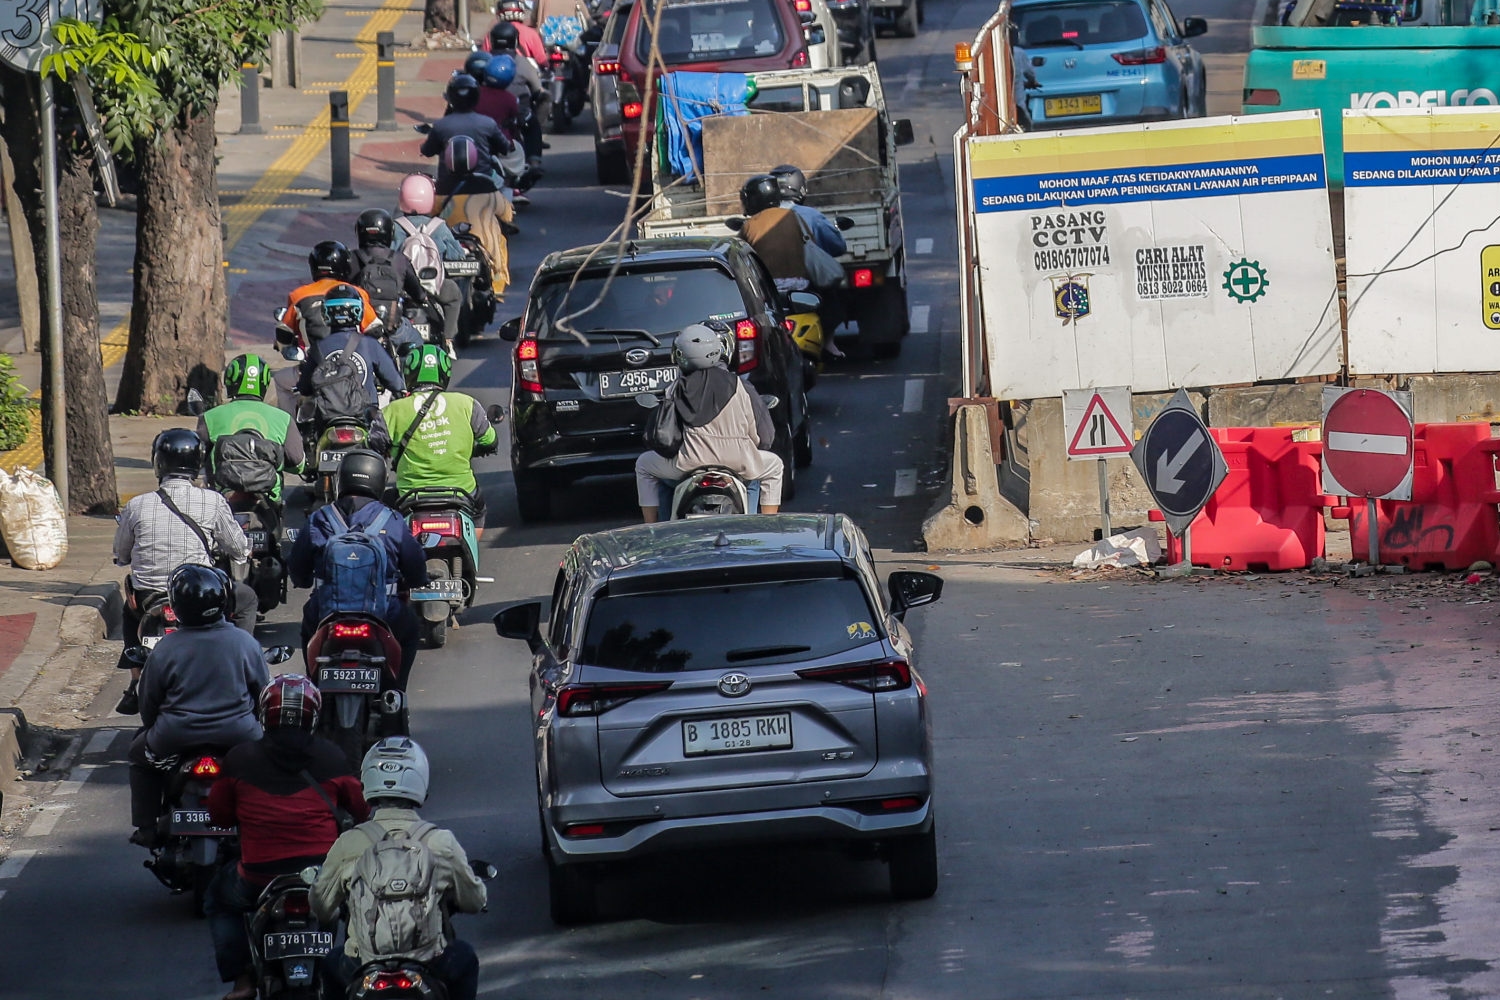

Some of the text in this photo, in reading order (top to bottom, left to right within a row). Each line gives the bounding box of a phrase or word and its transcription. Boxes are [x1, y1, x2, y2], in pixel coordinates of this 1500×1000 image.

[1411, 156, 1451, 166] MOHON
[1453, 155, 1482, 164] MAAF
[1039, 165, 1258, 189] MOHON MAAF ATAS KETIDAKNYAMANANNYA
[1352, 170, 1395, 180] SEDANG
[1397, 168, 1457, 178] DILAKUKAN
[1459, 167, 1490, 177] UPAYA
[982, 173, 1318, 206] SEDANG DILAKUKAN UPAYA PENINGKATAN LAYANAN AIR PERPIPAAN
[1031, 210, 1106, 230] PASANG
[653, 231, 686, 239] ISUZU
[1032, 226, 1106, 247] CCTV
[1034, 245, 1110, 271] 081806707074
[1136, 245, 1204, 265] CARI ALAT
[1137, 262, 1206, 282] MUSIK BEKAS
[1137, 279, 1207, 295] 0813 8022 0664
[602, 376, 609, 389] B
[620, 371, 648, 387] 2956
[419, 416, 450, 432] gojek
[421, 430, 451, 440] tokopedia
[428, 440, 448, 448] gopay
[323, 453, 347, 461] B 42
[143, 637, 149, 645] B
[323, 670, 377, 680] B 5923 TKJ
[687, 716, 787, 743] B 1885 RKW
[175, 813, 181, 823] B
[267, 933, 331, 946] B 3781 TLD
